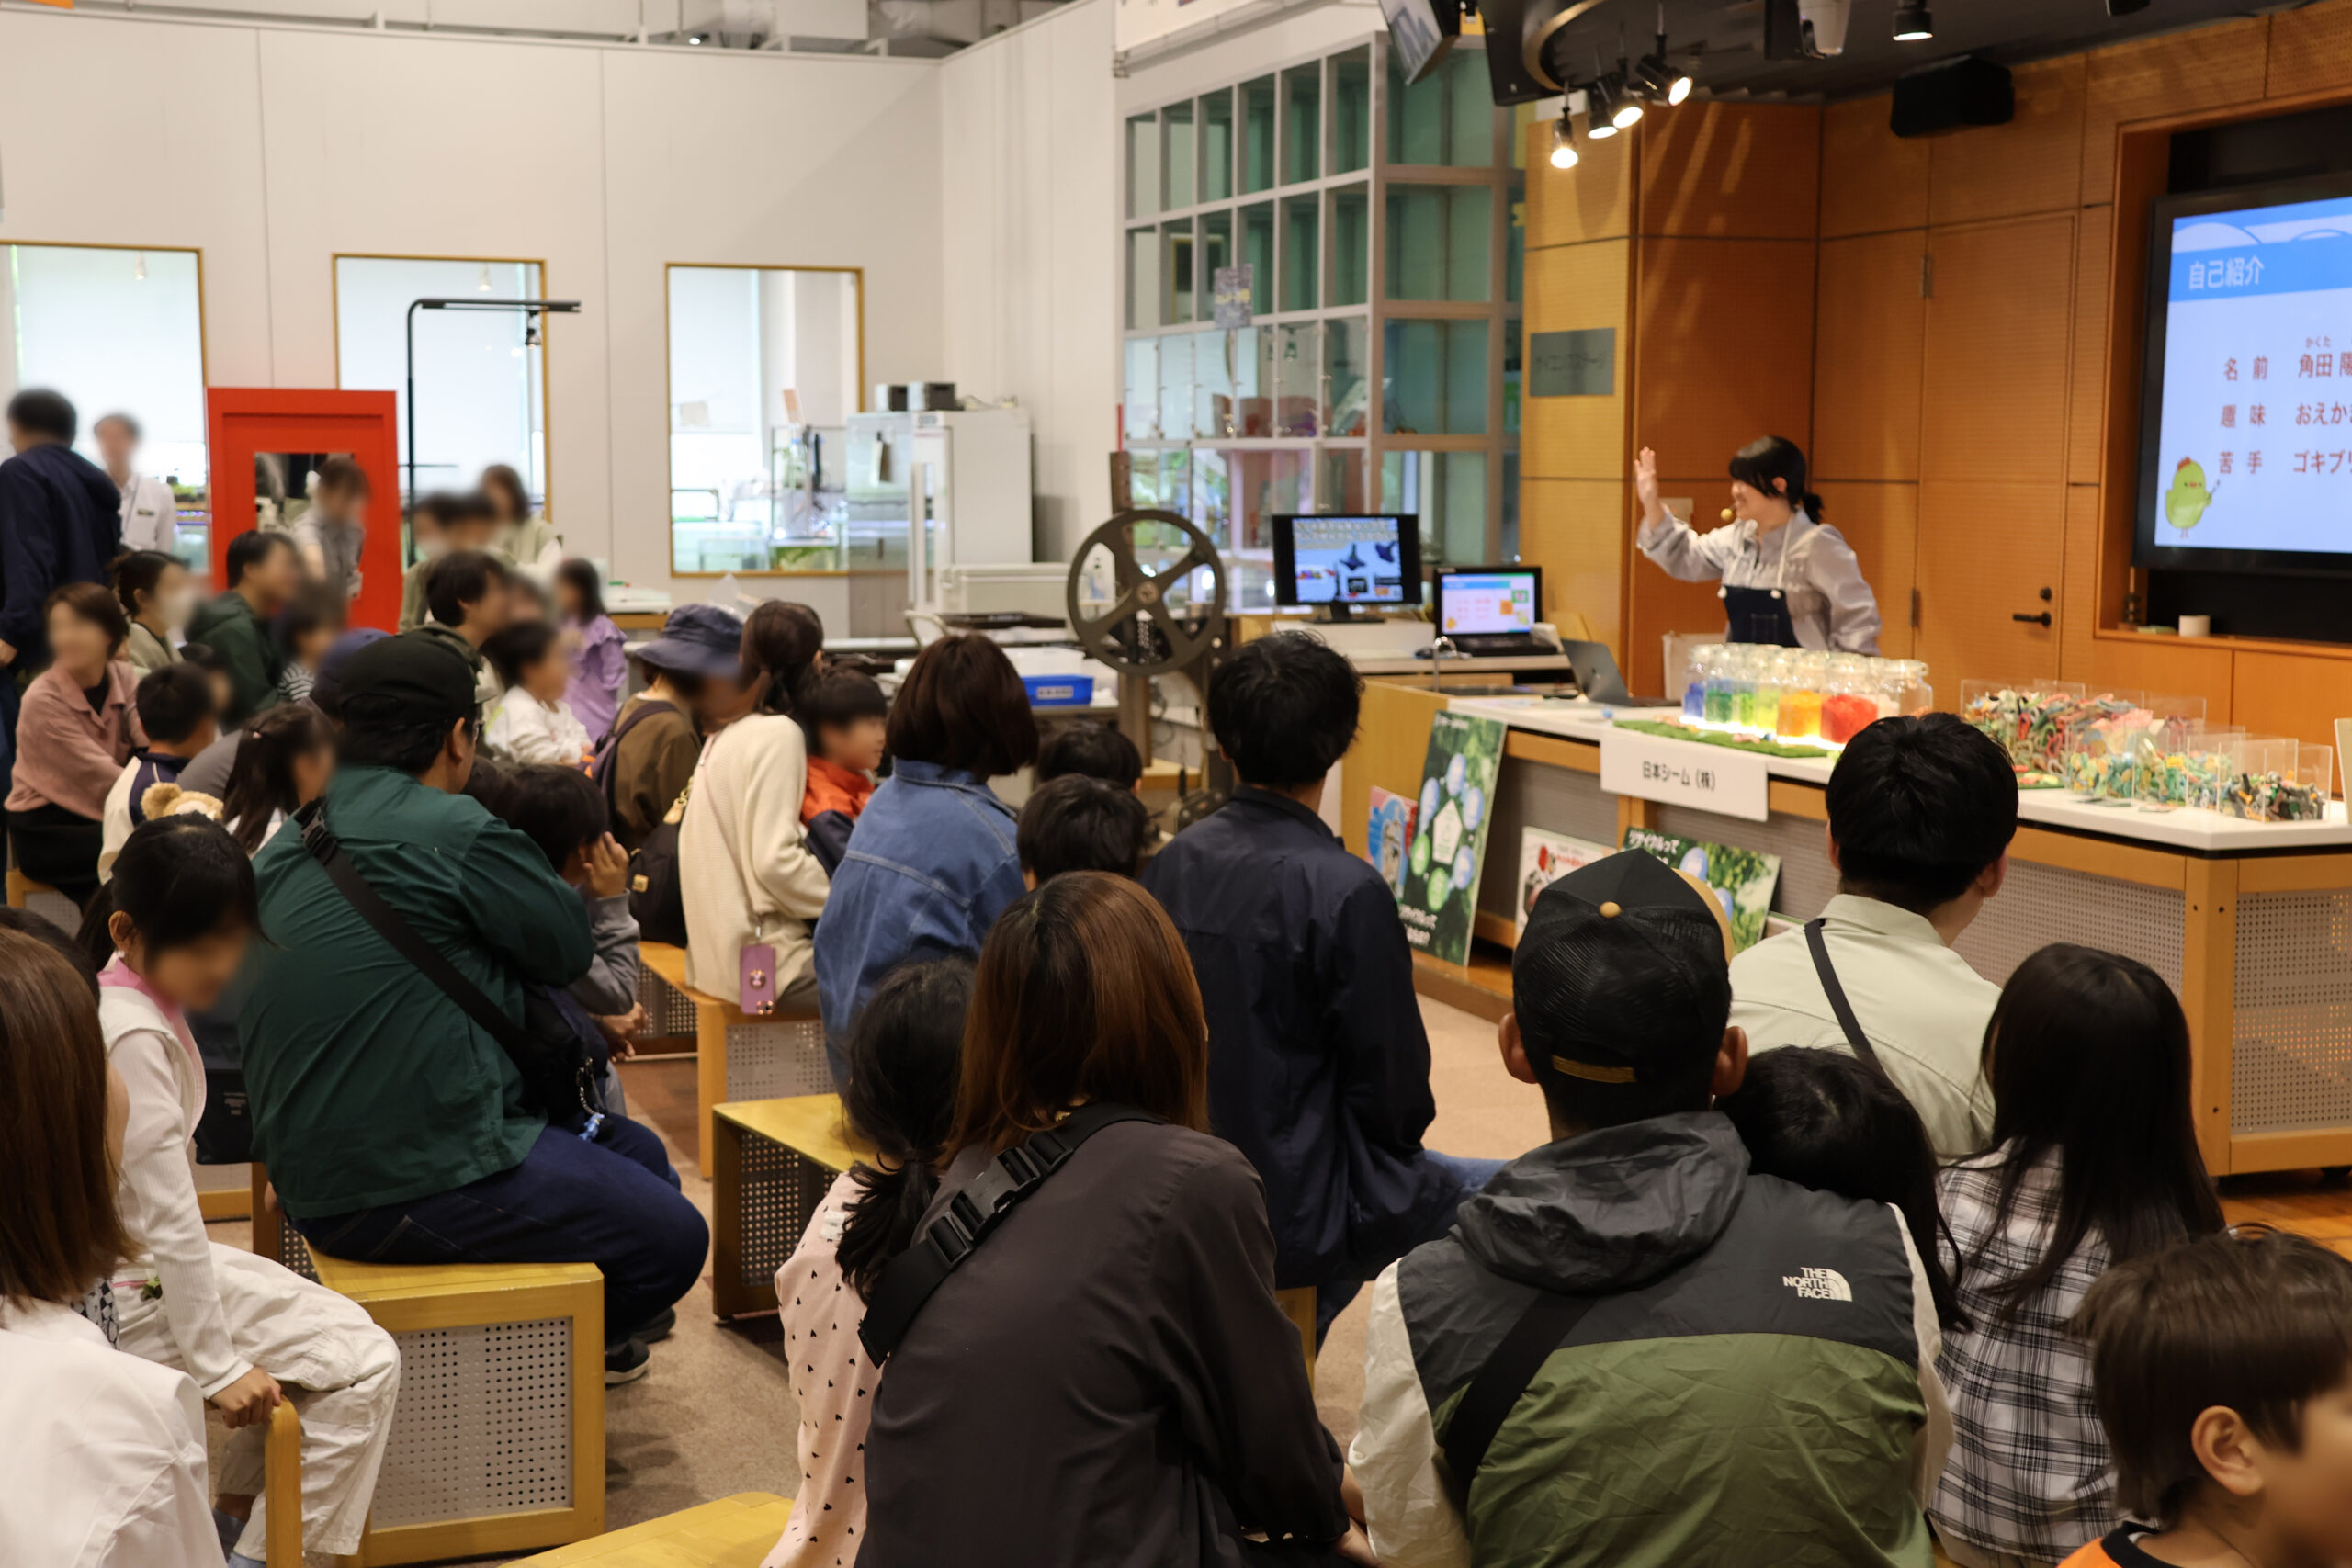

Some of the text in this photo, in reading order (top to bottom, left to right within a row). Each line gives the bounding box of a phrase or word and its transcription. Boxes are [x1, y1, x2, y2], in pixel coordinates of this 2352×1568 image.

[2189, 255, 2265, 289] 自己紹介
[2299, 354, 2333, 378] 角田
[2296, 401, 2352, 425] おえか
[1801, 1267, 1827, 1278] THE
[1782, 1276, 1828, 1288] NORTH
[1797, 1287, 1830, 1299] FACE
